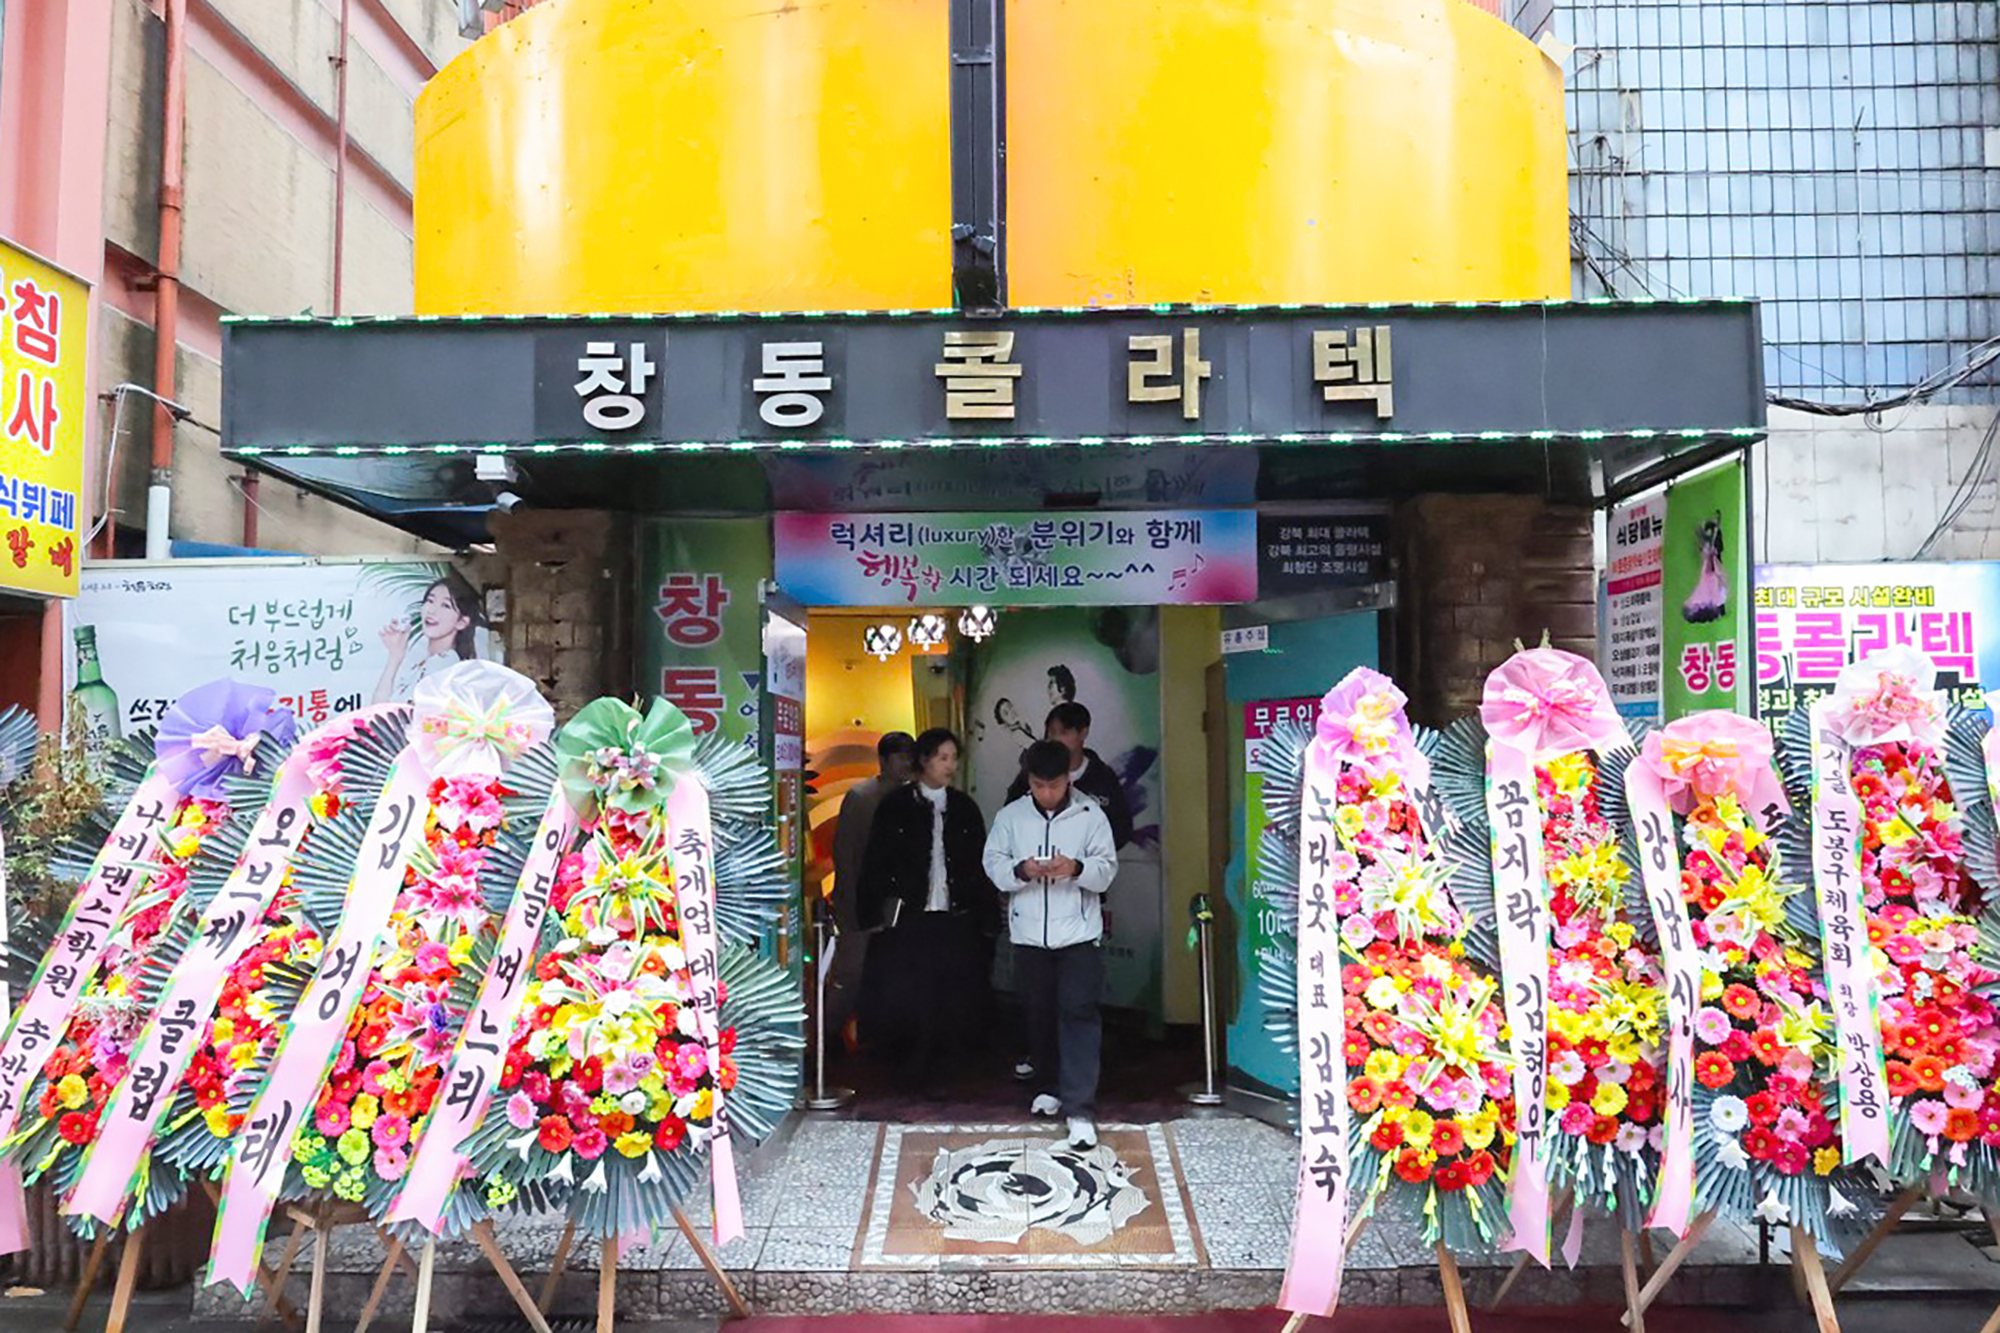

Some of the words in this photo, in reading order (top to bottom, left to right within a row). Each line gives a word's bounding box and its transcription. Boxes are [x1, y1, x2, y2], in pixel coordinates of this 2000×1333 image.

[0, 272, 58, 364] 침
[574, 325, 1393, 430] 창동콜라텍
[1030, 520, 1135, 550] 분위기와
[1146, 518, 1202, 550] 함께
[949, 566, 1000, 592] 시간
[1755, 586, 1797, 608] 최대
[1802, 586, 1845, 608] 규모
[1850, 585, 1935, 608] 시설완비
[228, 603, 256, 626] 더
[264, 598, 353, 633] 부드럽게
[230, 635, 344, 674] 처음처럼
[1681, 642, 1737, 692] 창동
[266, 689, 362, 723] 기통에
[1822, 748, 1848, 796] 서울
[204, 807, 297, 961] 오브제
[1495, 780, 1541, 943] 꼼지락
[44, 802, 166, 999] 나비댄스학원
[1309, 950, 1329, 1010] 대표
[1838, 982, 1859, 1019] 회장
[128, 999, 196, 1122] 클럽
[1846, 1032, 1882, 1120] 박상용
[1308, 1031, 1342, 1203] 김보숙
